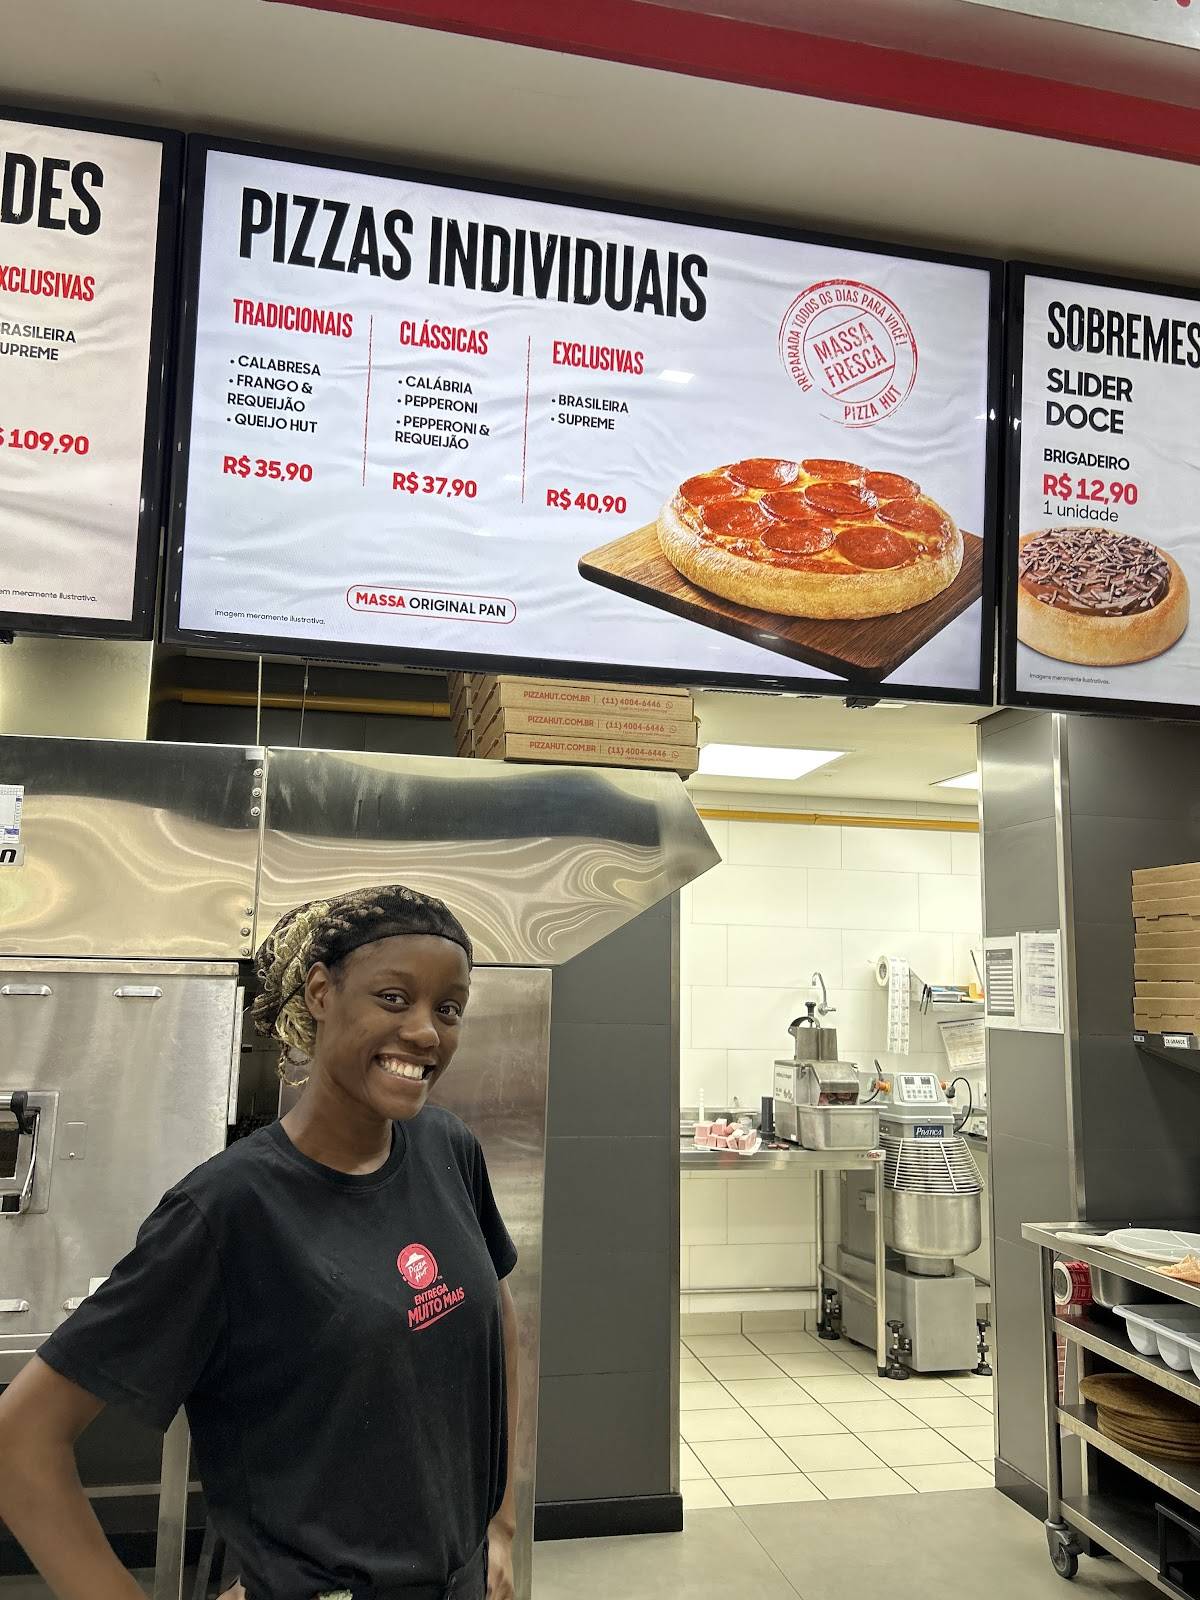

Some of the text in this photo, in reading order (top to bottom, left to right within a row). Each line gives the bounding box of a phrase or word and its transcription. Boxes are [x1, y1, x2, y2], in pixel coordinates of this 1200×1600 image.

[1, 152, 104, 235] DES
[238, 186, 708, 321] PIZZAS INDIVIDUAIS
[233, 298, 353, 338] TRADICIONAIS
[0, 322, 76, 343] RASILEIRA
[400, 319, 488, 355] CLÁSSICAS
[787, 289, 908, 393] PREPARADA TODOS OS DIAS PARA VOCÊ!
[812, 321, 874, 364] MASSA
[1047, 301, 1200, 369] SOBREMES
[0, 342, 59, 360] UPREME
[552, 340, 644, 375] EXCLUSIVAS
[238, 355, 321, 376] CALABRESA
[823, 344, 887, 388] FRESCA
[236, 374, 313, 394] FRANGO &
[405, 375, 473, 395] CALÁBRIA
[1046, 367, 1133, 402] SLIDER
[227, 391, 305, 412] REQUEIJÃO
[404, 394, 478, 414] PEPPERONI
[558, 394, 629, 414] BRASILEIRA
[844, 384, 902, 420] PIZZA HUT
[235, 413, 317, 433] QUEIJO HUT
[403, 415, 490, 436] PEPPERONI &
[557, 413, 615, 430] SUPREME
[1045, 400, 1124, 435] DOCE
[8, 429, 89, 455] 109,90
[394, 431, 469, 449] REQUEIJÃO
[223, 455, 313, 482] R$ 35,90
[1043, 448, 1130, 470] BRIGADEIRO
[392, 472, 477, 498] R$ 37,90
[1043, 472, 1138, 505] R$ 12,90
[546, 488, 627, 514] R$ 40,90
[1043, 500, 1119, 522] 1 unidade
[12, 589, 57, 599] meramente
[355, 592, 506, 617] MASSA ORIGINAL PAN
[246, 612, 288, 622] meramente
[523, 690, 661, 708] PIZZAHUT.COM.BR (11) 4004-6446
[528, 715, 664, 732] PIZZAHUT.COM.BR (11) 4004-6446
[530, 741, 667, 757] PIZZAHUT.COM.BR (11) 4004-6446
[408, 1260, 427, 1278] Pizza
[415, 1266, 428, 1283] Hut
[414, 1283, 449, 1305] ENTREGA
[407, 1286, 465, 1328] MUITO MAIS
